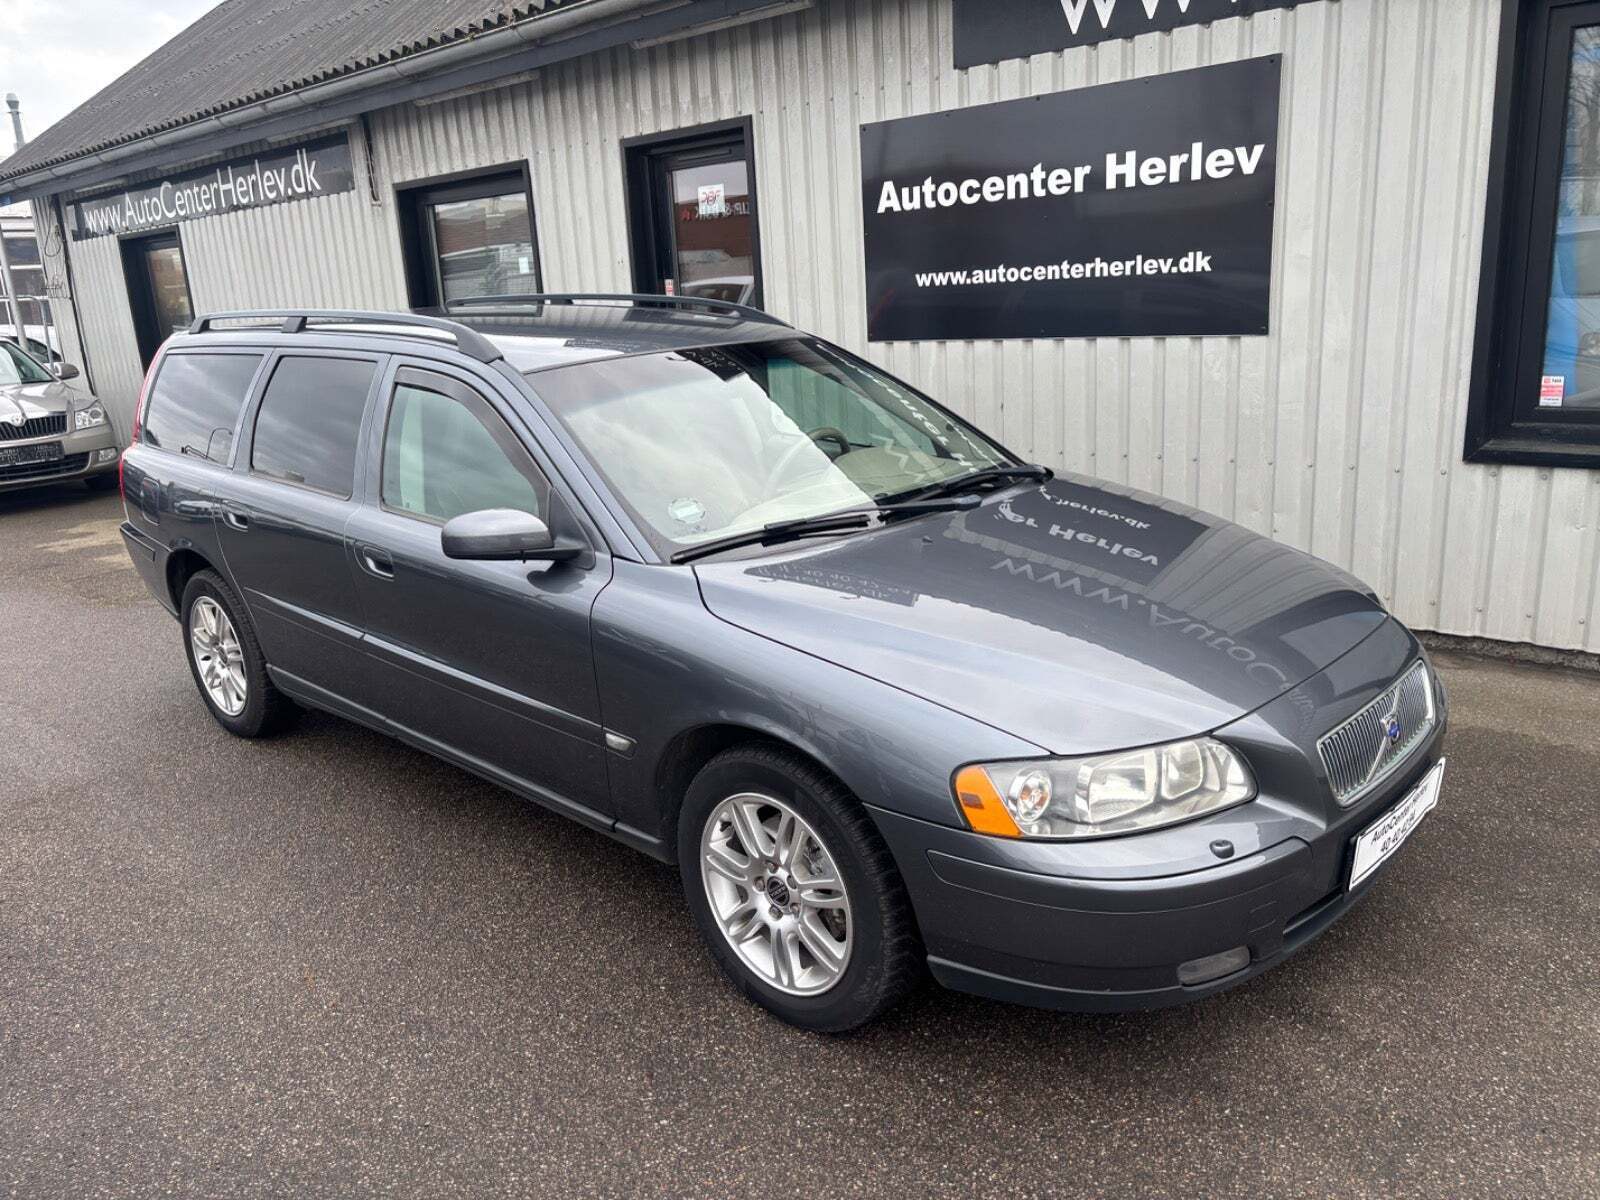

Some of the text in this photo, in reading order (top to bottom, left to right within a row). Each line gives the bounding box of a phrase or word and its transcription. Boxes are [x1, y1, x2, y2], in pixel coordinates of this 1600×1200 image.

[83, 147, 322, 233] www.AutoCenterHerlev.dk
[876, 141, 1265, 214] Autocenter Herlev
[915, 250, 1213, 288] www.autocenterherlev.dk
